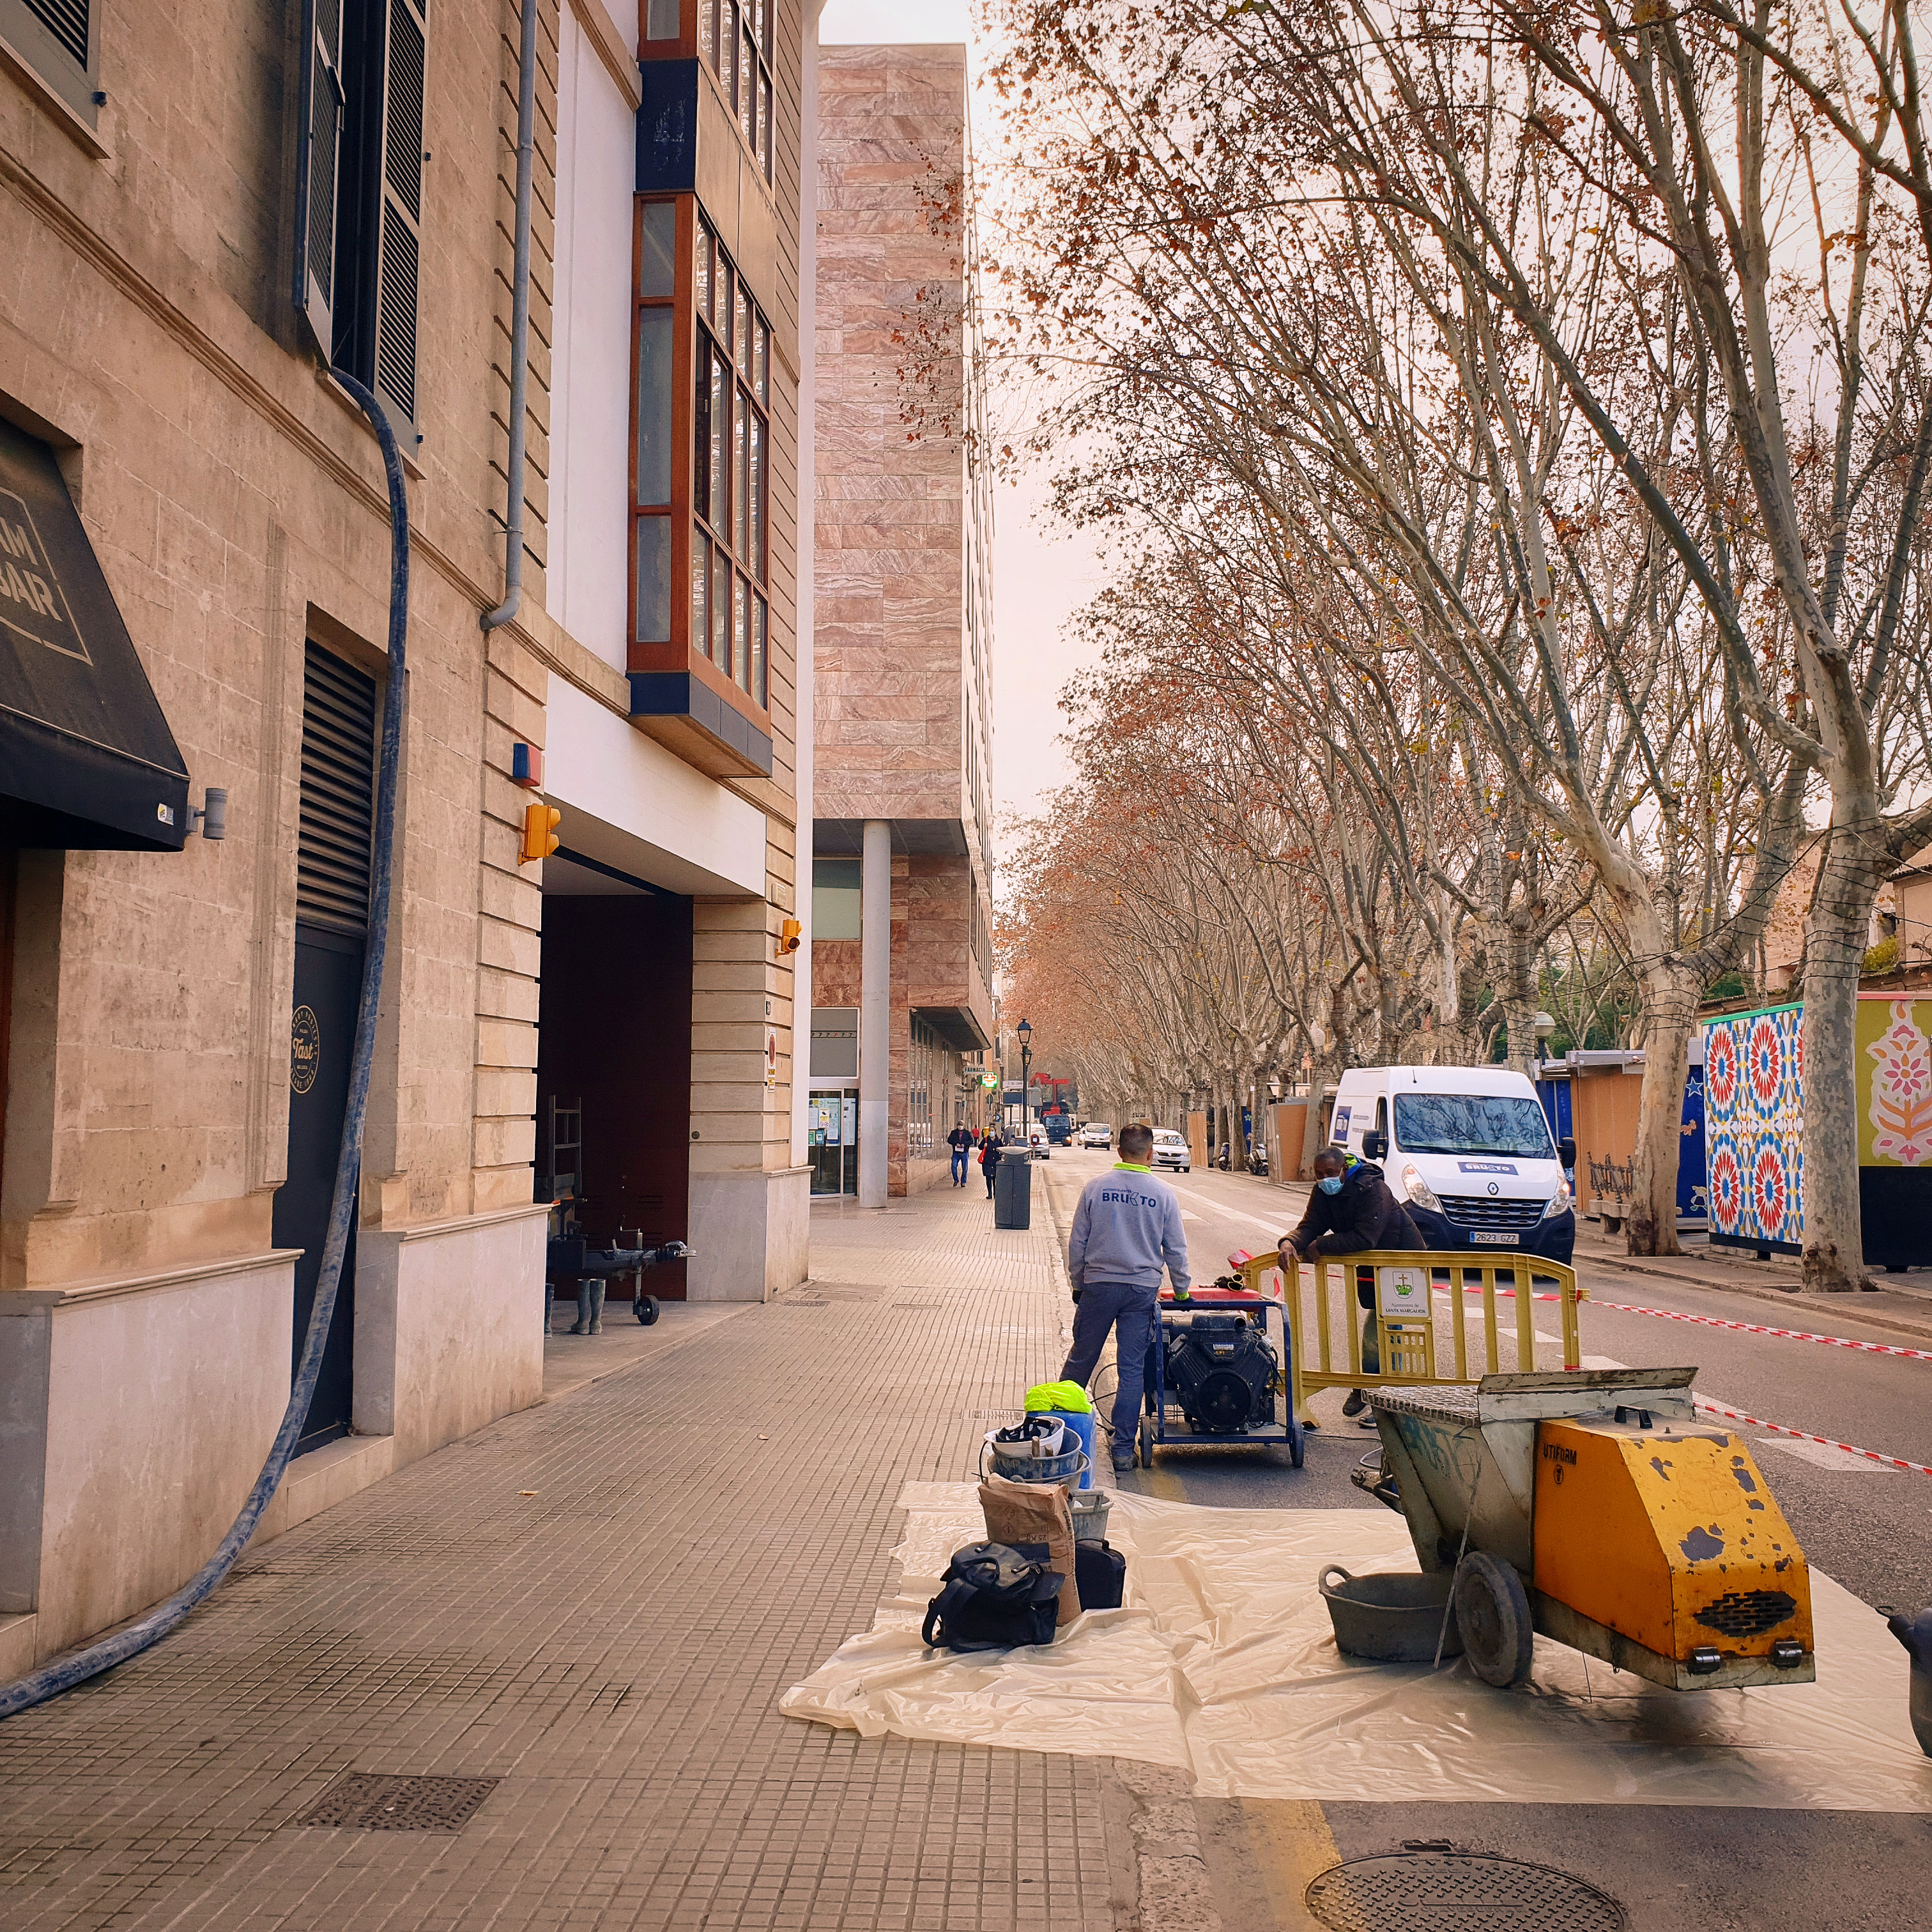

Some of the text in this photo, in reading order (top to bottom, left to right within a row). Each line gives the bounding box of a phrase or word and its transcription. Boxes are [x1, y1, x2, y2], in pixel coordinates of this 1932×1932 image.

[1476, 1233, 1516, 1243] 2623 GZZ
[1544, 1443, 1577, 1465] UTIFORM
